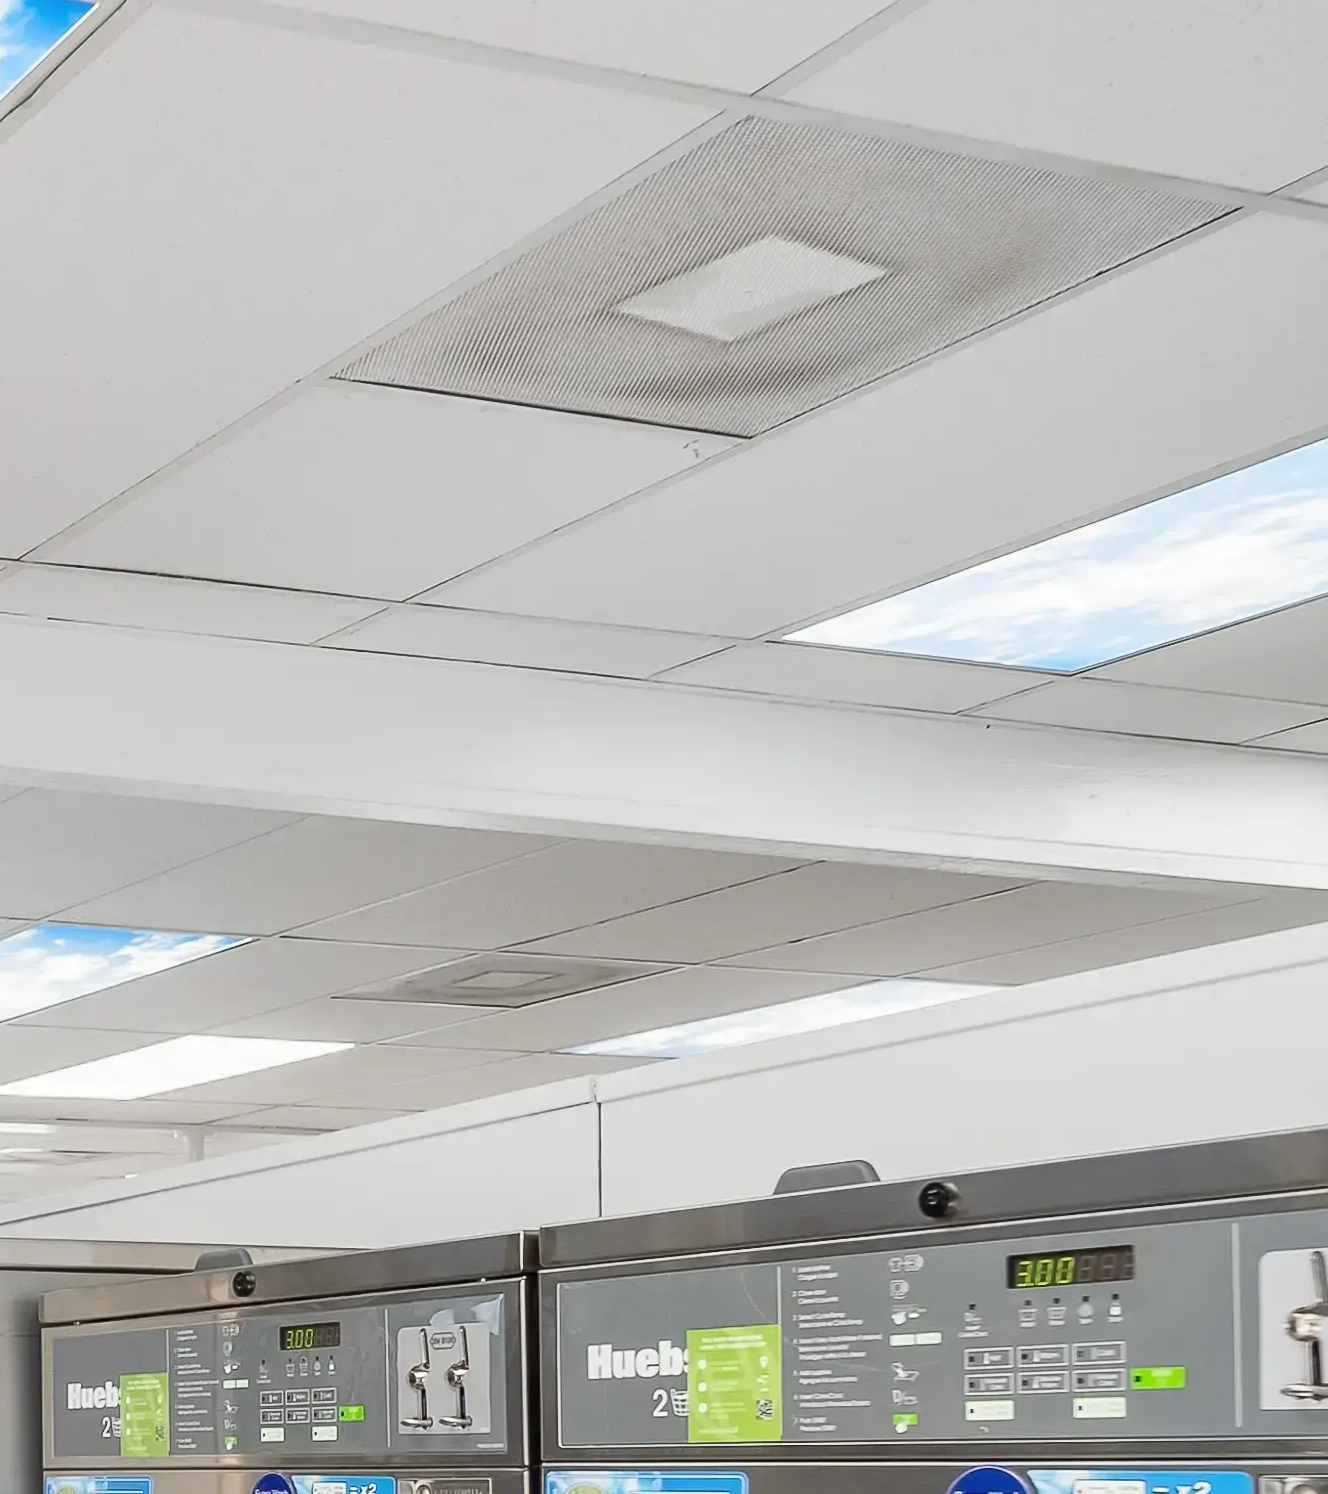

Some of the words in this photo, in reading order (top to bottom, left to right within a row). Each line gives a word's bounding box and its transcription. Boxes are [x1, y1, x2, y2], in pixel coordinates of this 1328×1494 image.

[588, 1339, 690, 1380] Hueb
[67, 1381, 121, 1410] Hueb
[652, 1388, 669, 1417] 2
